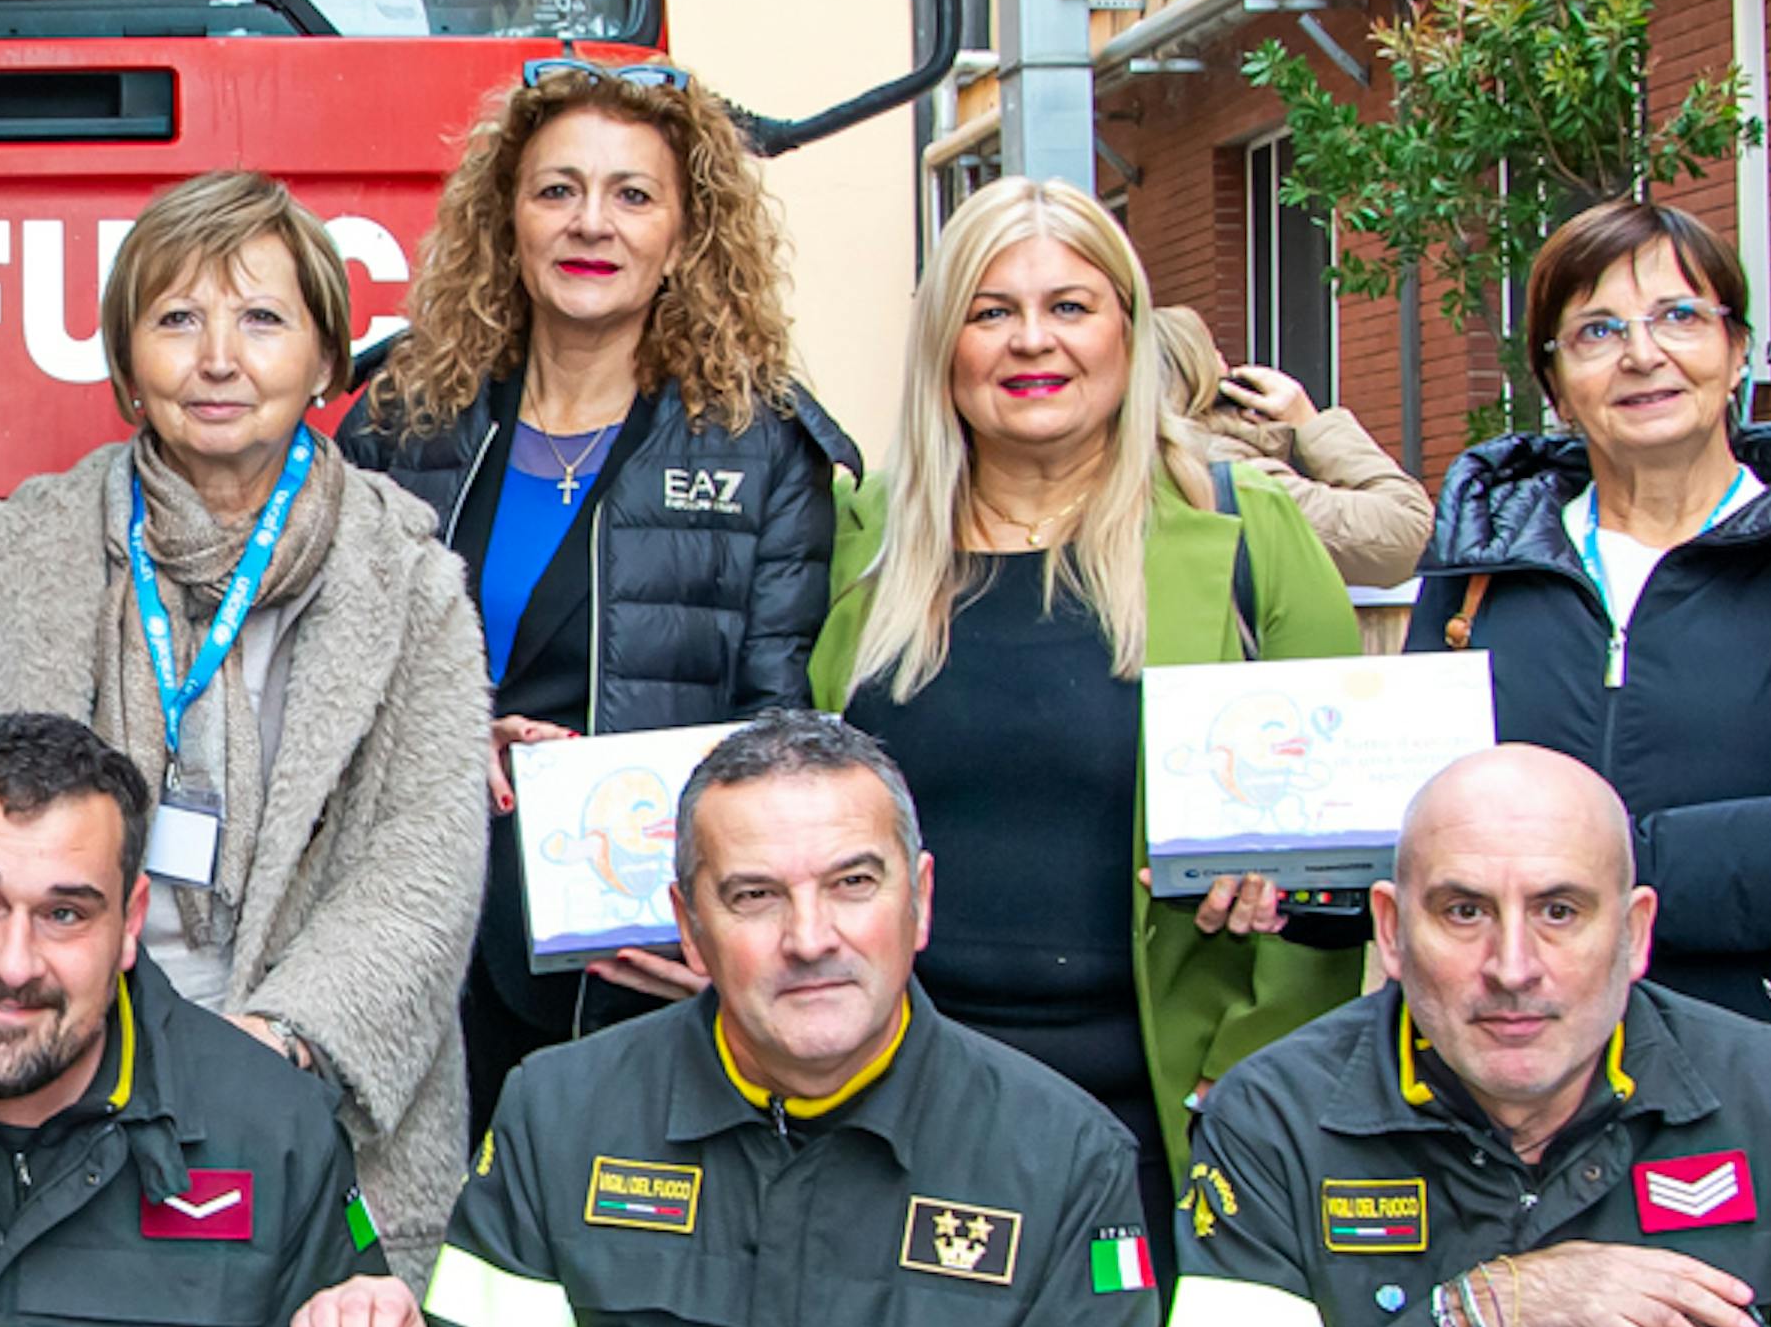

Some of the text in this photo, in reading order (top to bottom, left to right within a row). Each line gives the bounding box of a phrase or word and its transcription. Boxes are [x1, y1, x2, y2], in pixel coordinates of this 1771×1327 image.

[664, 468, 746, 502] EA7
[226, 575, 252, 632] unicef
[599, 1171, 691, 1201] VIGILI DEL FUOCO
[1327, 1196, 1420, 1219] VIGILI DEL FUOCO
